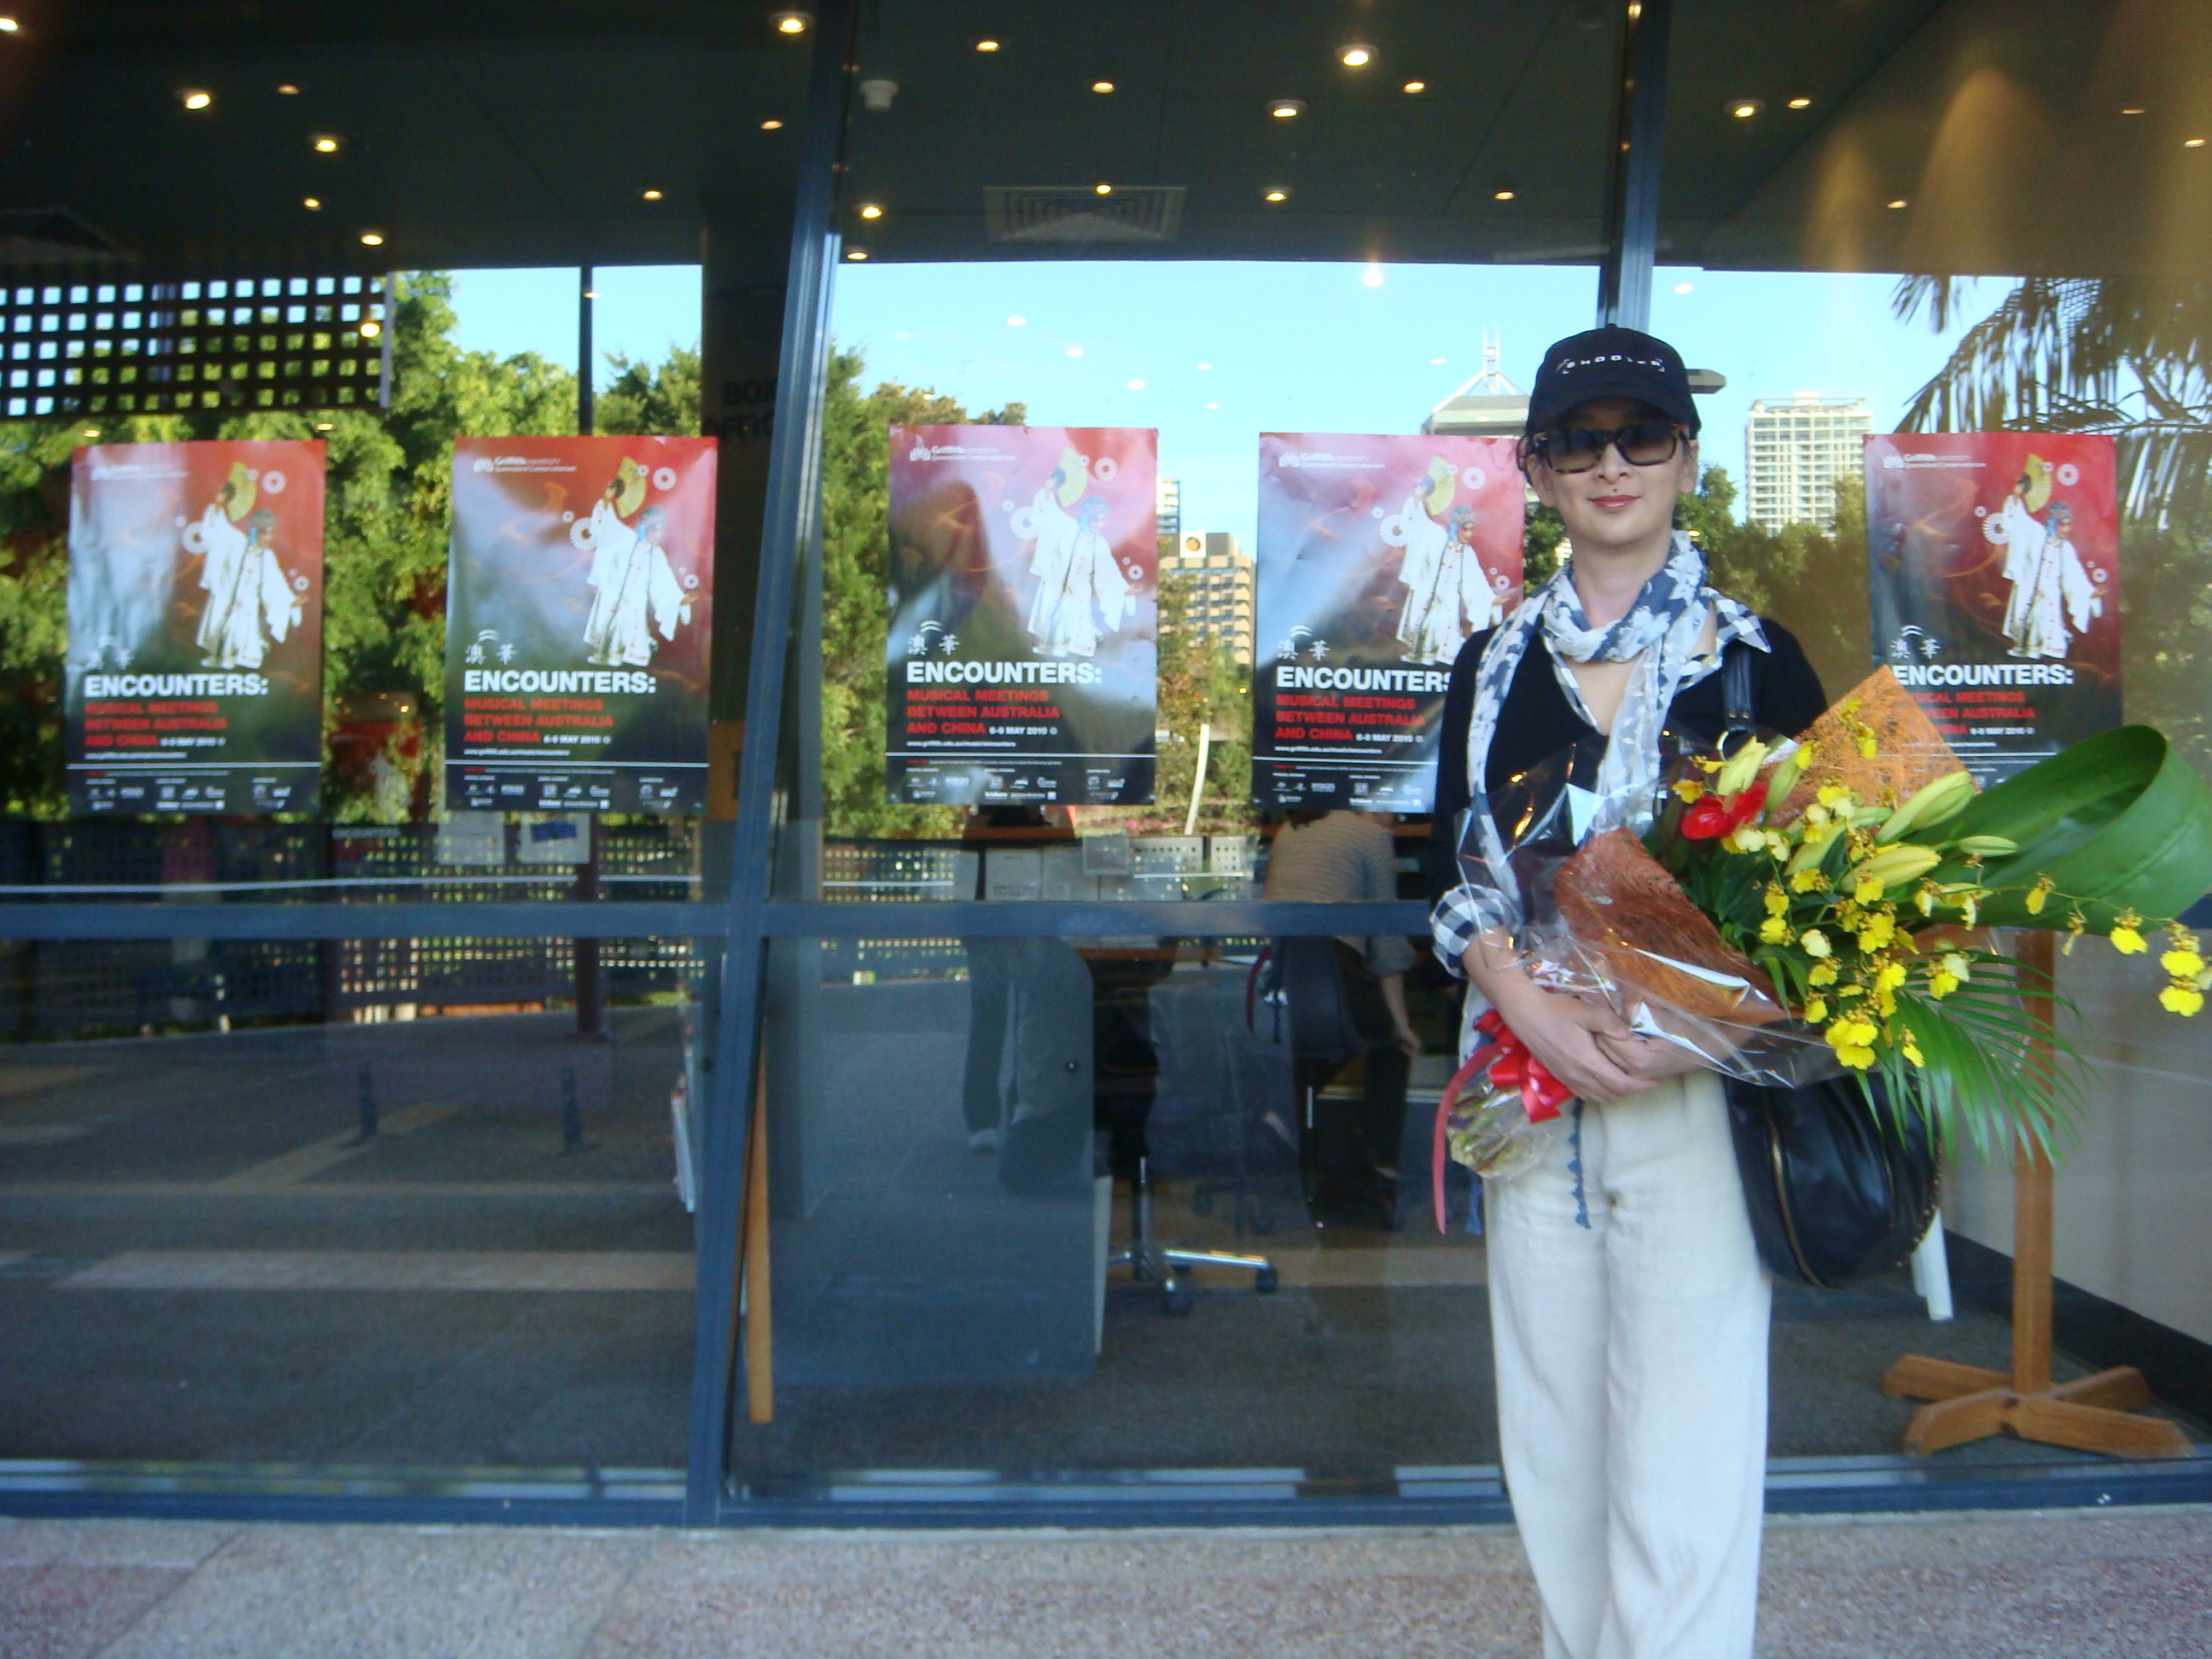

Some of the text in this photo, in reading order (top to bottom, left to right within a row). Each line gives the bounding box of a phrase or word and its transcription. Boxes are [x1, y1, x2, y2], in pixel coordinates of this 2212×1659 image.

[906, 661, 1103, 684] ENCOUNTERS:
[1276, 666, 1451, 693] ENCOUNTER
[1892, 664, 2075, 685] ENCOUNTERS:
[84, 673, 269, 697] ENCOUNTERS:
[463, 669, 656, 694] ENCOUNTERS:
[906, 690, 1049, 701] MUSICAL MEETINGS
[1275, 694, 1416, 709] MUSICAL MEETINGS
[1955, 691, 2026, 703] MEETINGS
[905, 706, 1060, 718] BETWEEN AUSTRALIA
[1275, 711, 1345, 724] BETWEEN
[1963, 707, 2036, 719] AUSTRALIA
[536, 715, 614, 727] AUSTRALIA
[906, 722, 937, 734] AND
[940, 722, 986, 734] CHINA
[1006, 726, 1026, 735] MAY
[1026, 727, 1048, 736] 2010
[1274, 727, 1306, 739] AND
[1308, 728, 1353, 741] CHINA
[1372, 733, 1392, 742] MAY
[463, 730, 494, 742] AND
[497, 731, 541, 743] CHINA
